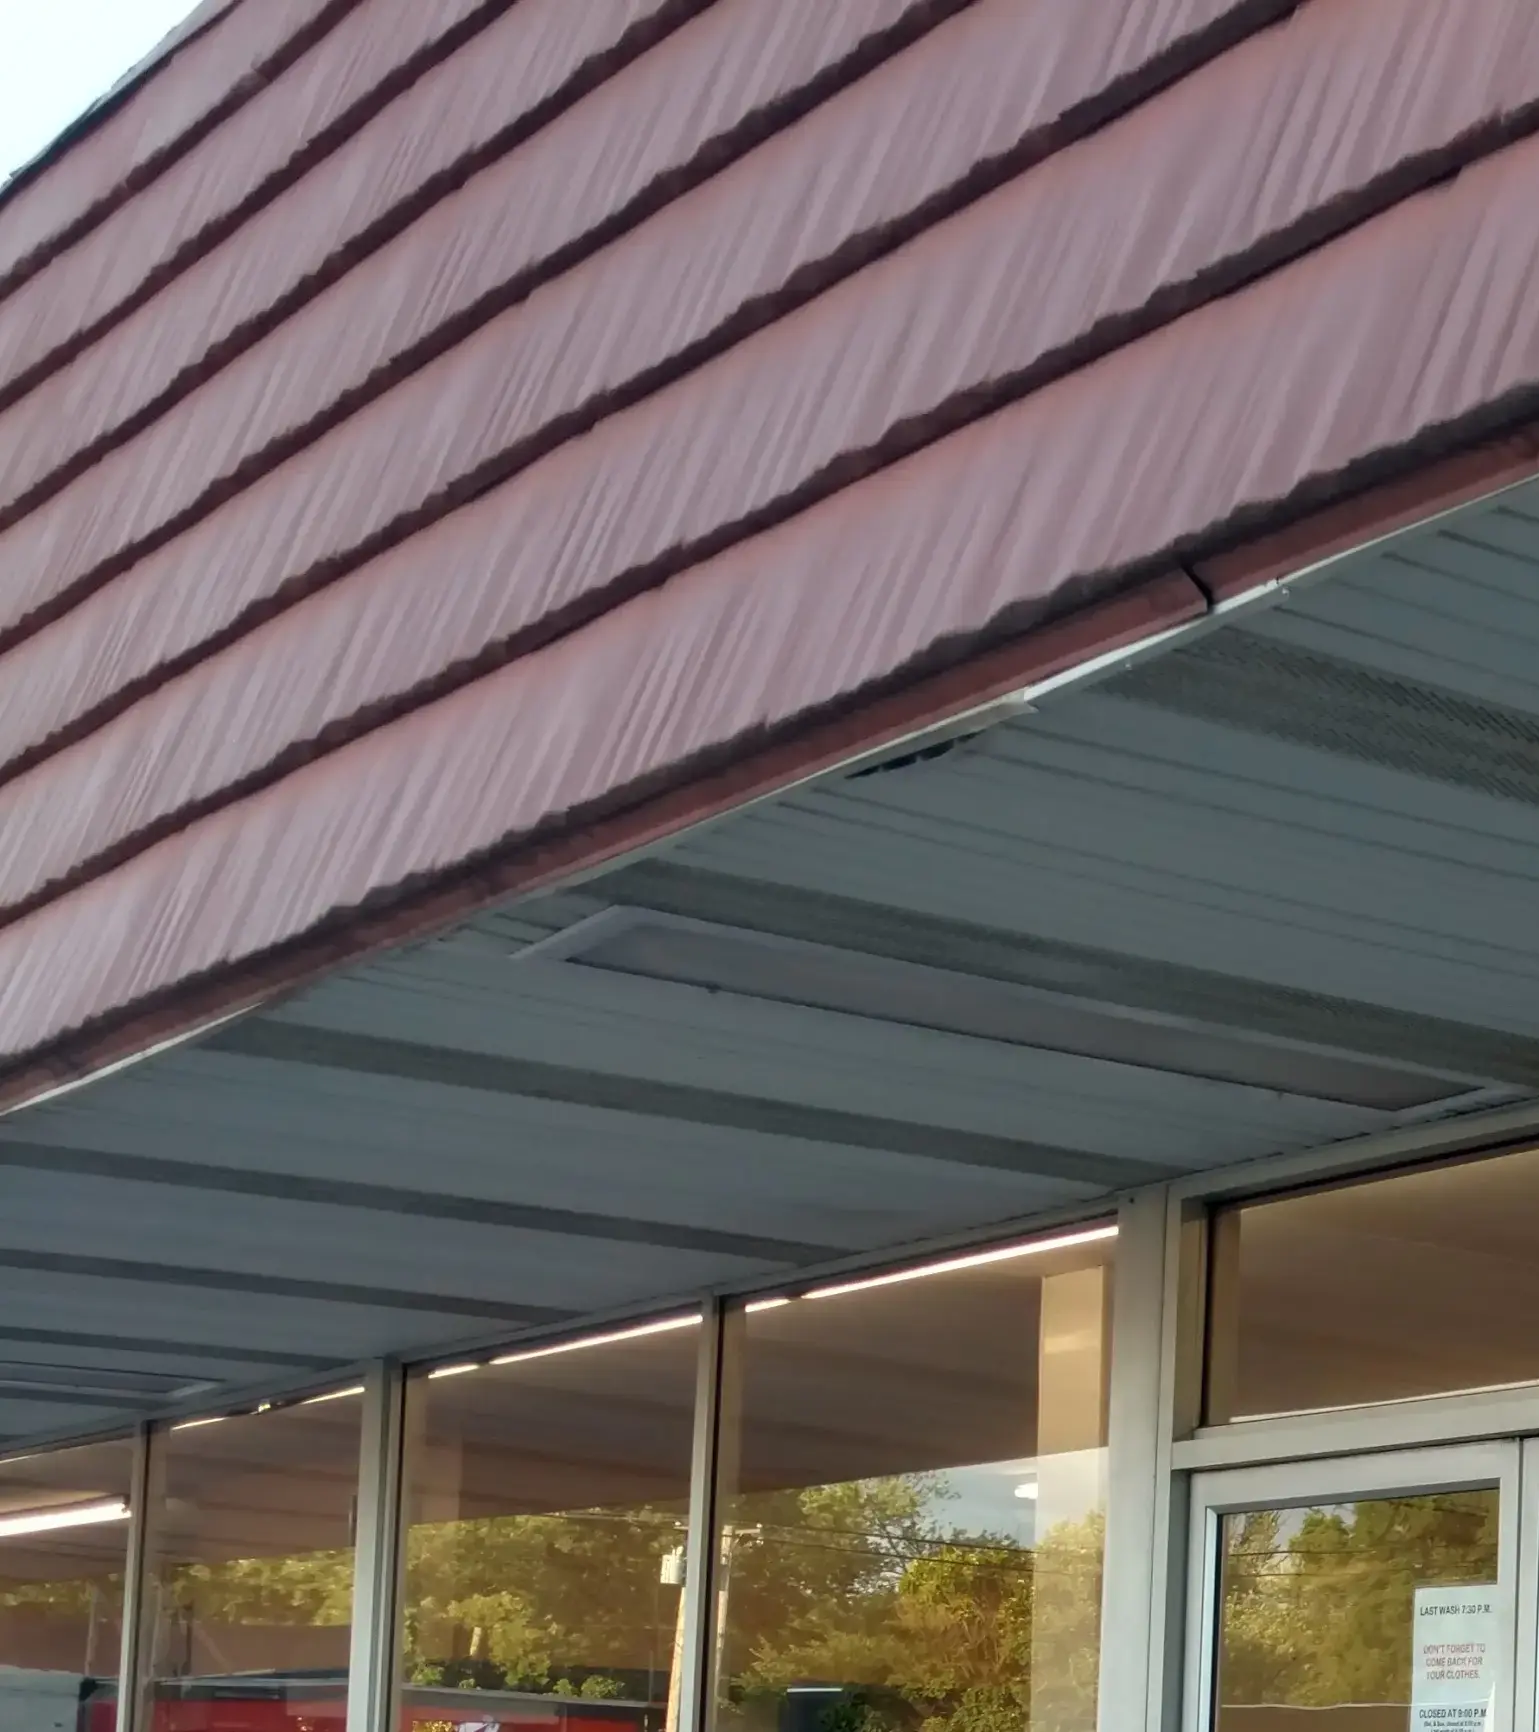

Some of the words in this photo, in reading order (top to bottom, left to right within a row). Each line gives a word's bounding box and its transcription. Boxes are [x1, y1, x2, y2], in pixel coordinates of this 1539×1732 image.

[1420, 1606, 1438, 1616] LAST
[1439, 1605, 1460, 1615] WASH
[1461, 1604, 1476, 1614] 7:30
[1423, 1644, 1445, 1654] DON'T
[1446, 1643, 1474, 1653] FORGET
[1476, 1643, 1486, 1653] TO
[1426, 1658, 1446, 1667] COME
[1447, 1657, 1466, 1667] BACK
[1467, 1656, 1483, 1666] FOR
[1427, 1671, 1445, 1680] YOUR
[1419, 1709, 1447, 1718] CLOSED
[1447, 1708, 1457, 1718] AT
[1458, 1708, 1473, 1718] 9:00
